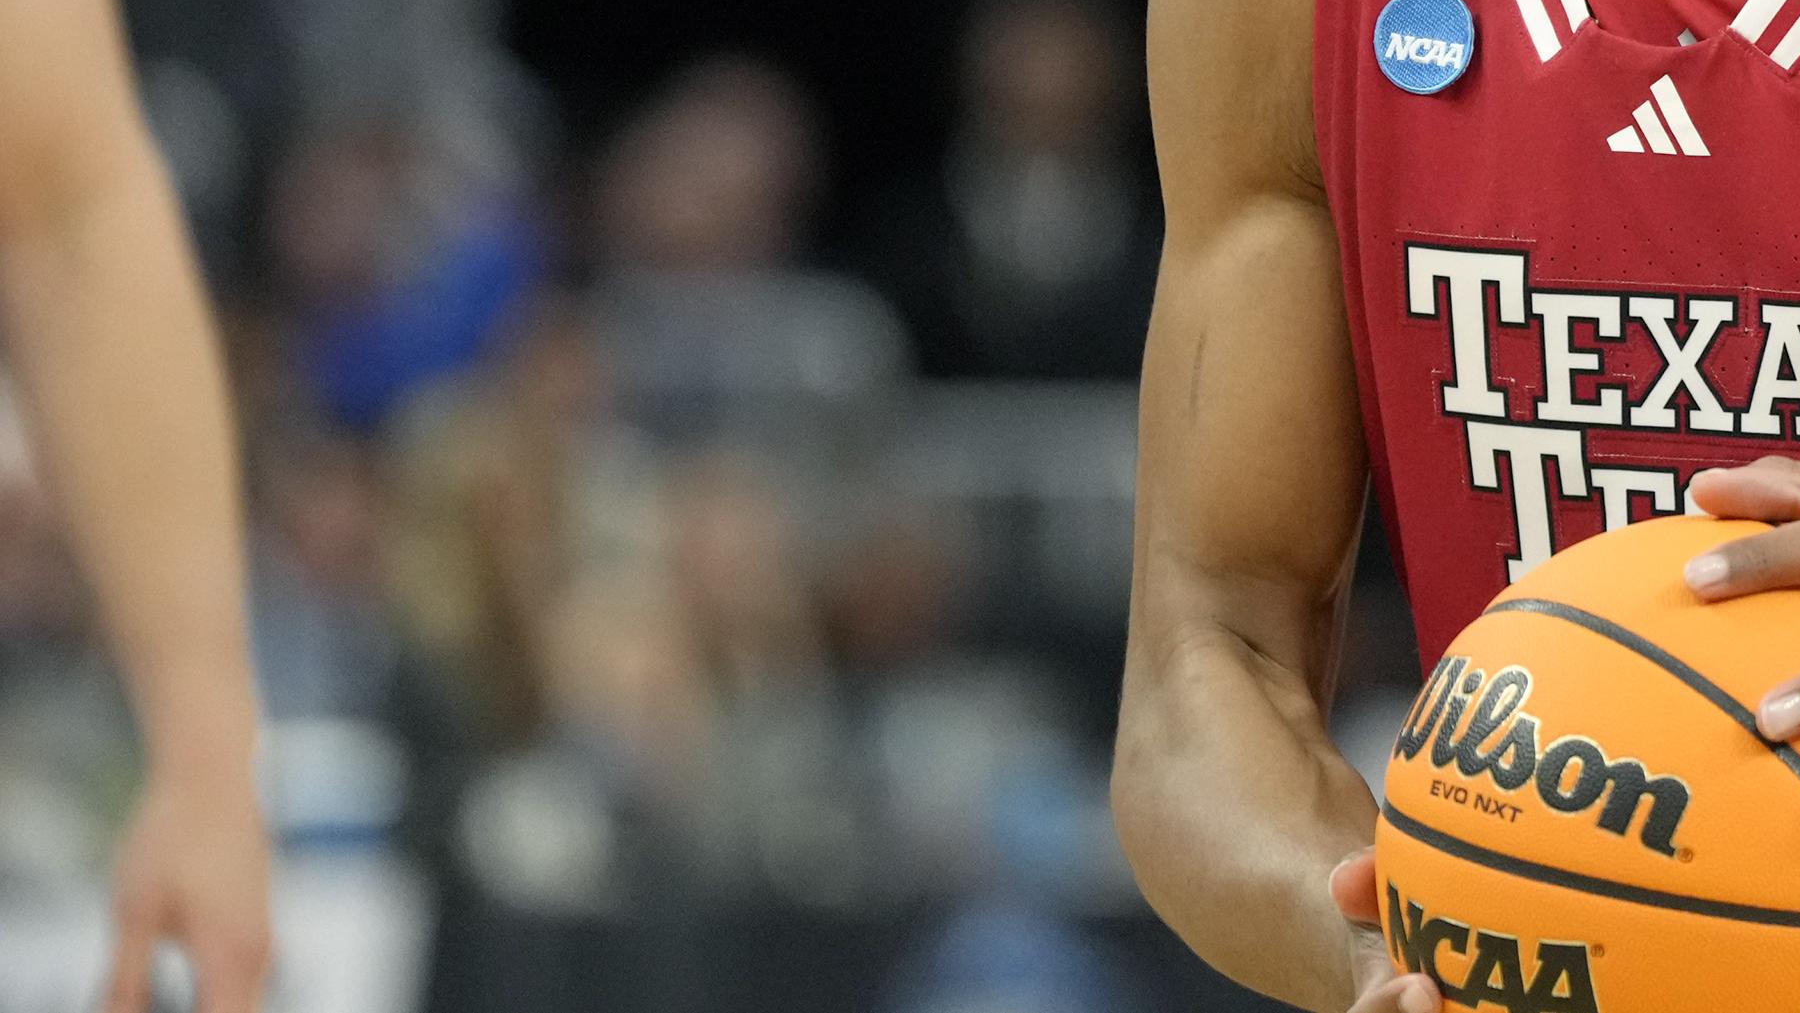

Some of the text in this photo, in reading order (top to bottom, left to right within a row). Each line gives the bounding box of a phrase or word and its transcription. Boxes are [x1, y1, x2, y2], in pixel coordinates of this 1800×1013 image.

[1385, 32, 1465, 69] NCAA
[1393, 655, 1693, 858] Wilson
[1429, 779, 1524, 824] EVO NXT
[1387, 879, 1600, 1013] NCAA
